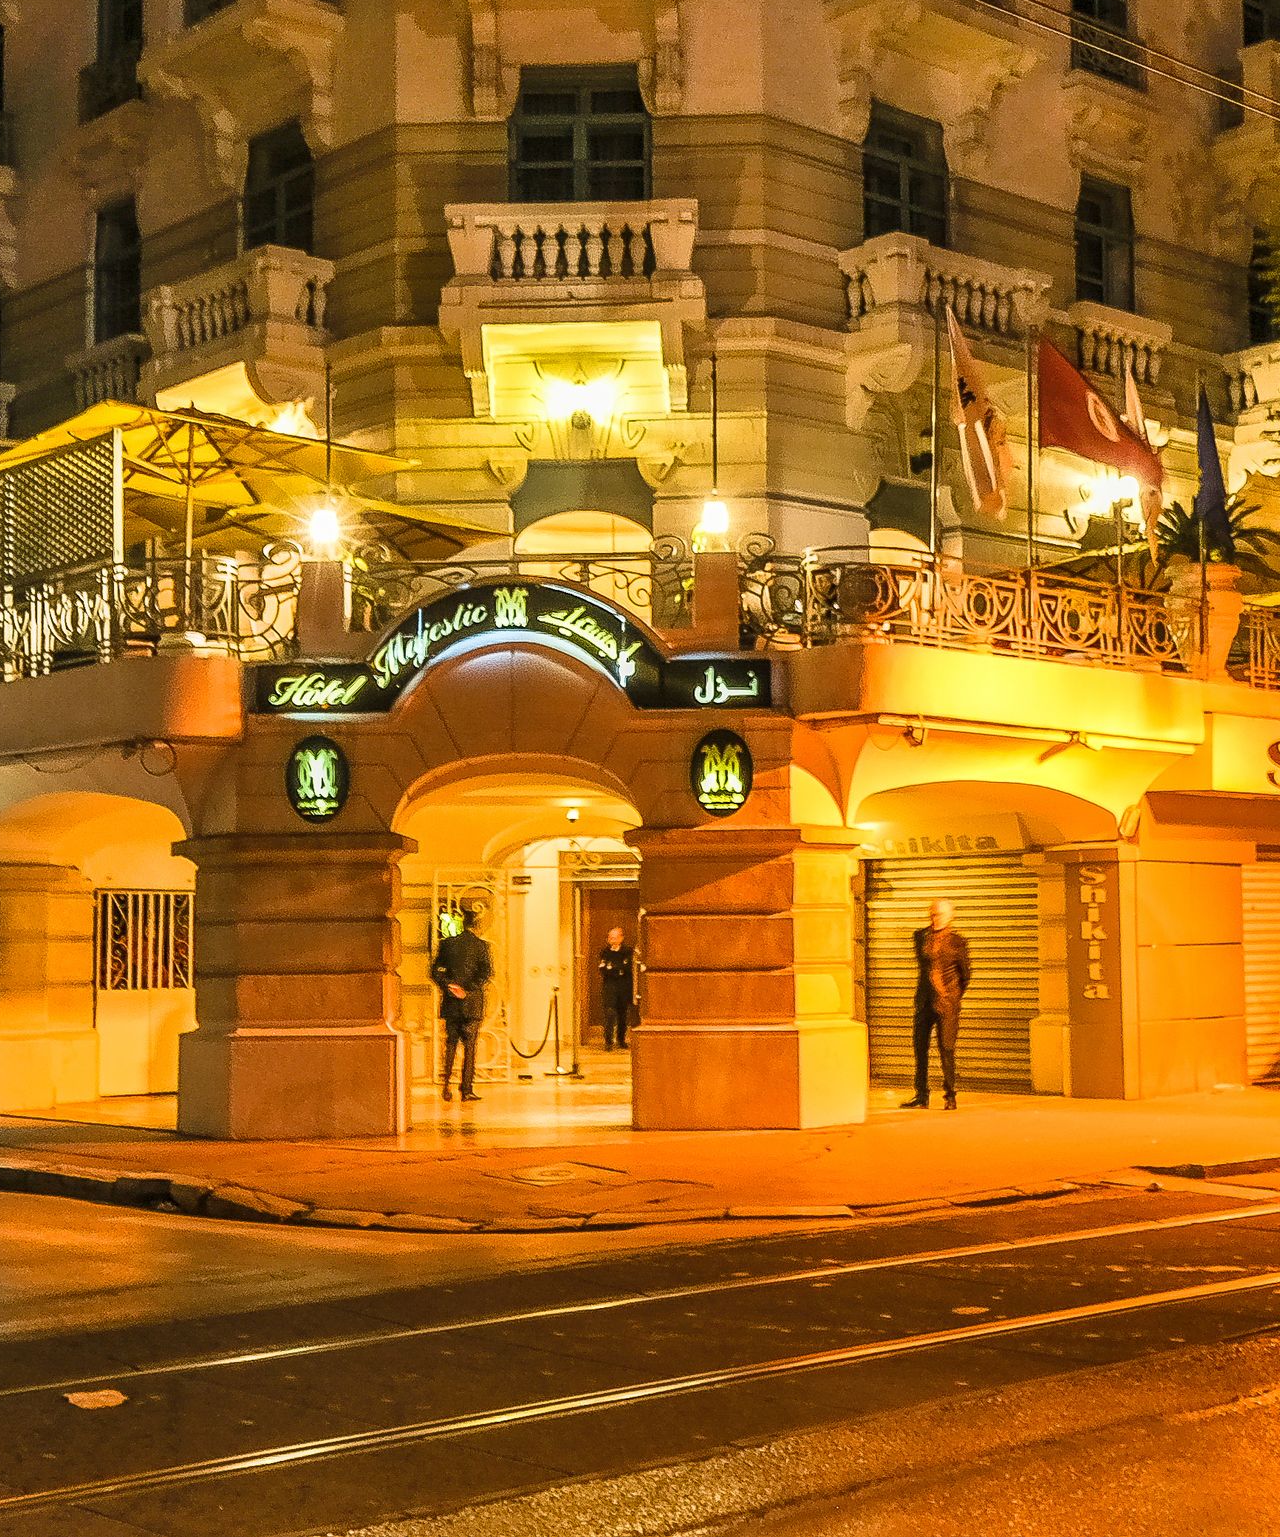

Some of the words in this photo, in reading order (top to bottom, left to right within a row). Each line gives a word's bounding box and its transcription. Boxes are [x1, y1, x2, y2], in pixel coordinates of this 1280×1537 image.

[268, 672, 368, 707] Hôtel
[373, 603, 488, 689] Majestic
[693, 665, 759, 704] نزل
[1079, 867, 1111, 999] Shikita
